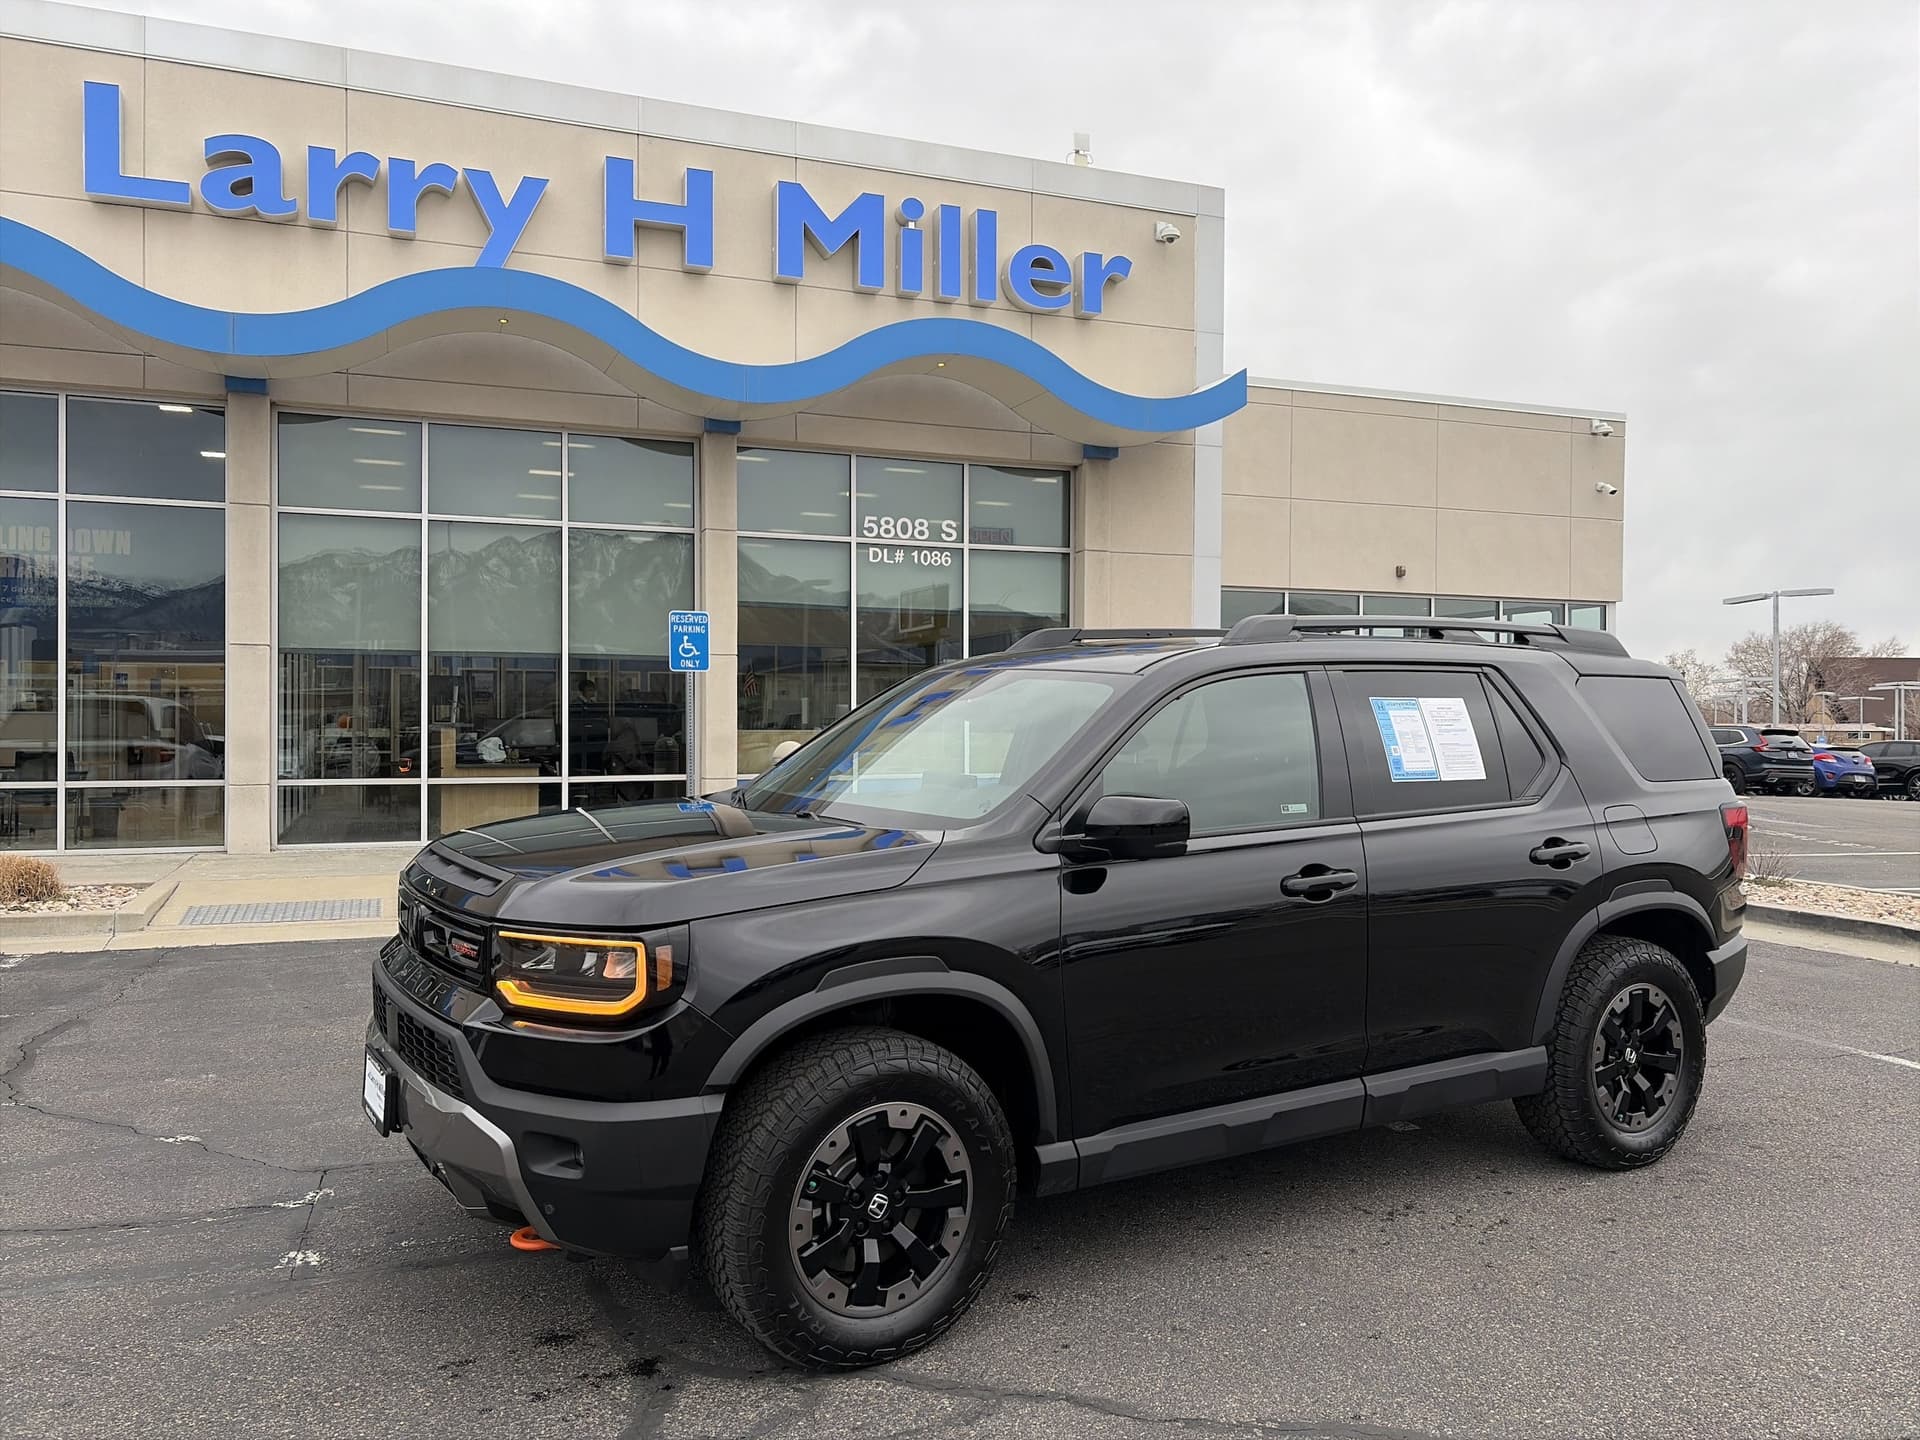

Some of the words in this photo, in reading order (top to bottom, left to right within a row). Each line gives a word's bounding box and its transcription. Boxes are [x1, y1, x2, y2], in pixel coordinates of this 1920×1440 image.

[82, 80, 549, 268] Larry
[603, 155, 714, 273] H
[772, 179, 1133, 318] Miller
[863, 515, 930, 541] 5808
[940, 519, 958, 542] S
[868, 547, 905, 565] DL#
[911, 549, 952, 567] 1086
[671, 614, 708, 624] RESERVED
[673, 624, 706, 634] PARKING
[680, 659, 701, 668] ONLY
